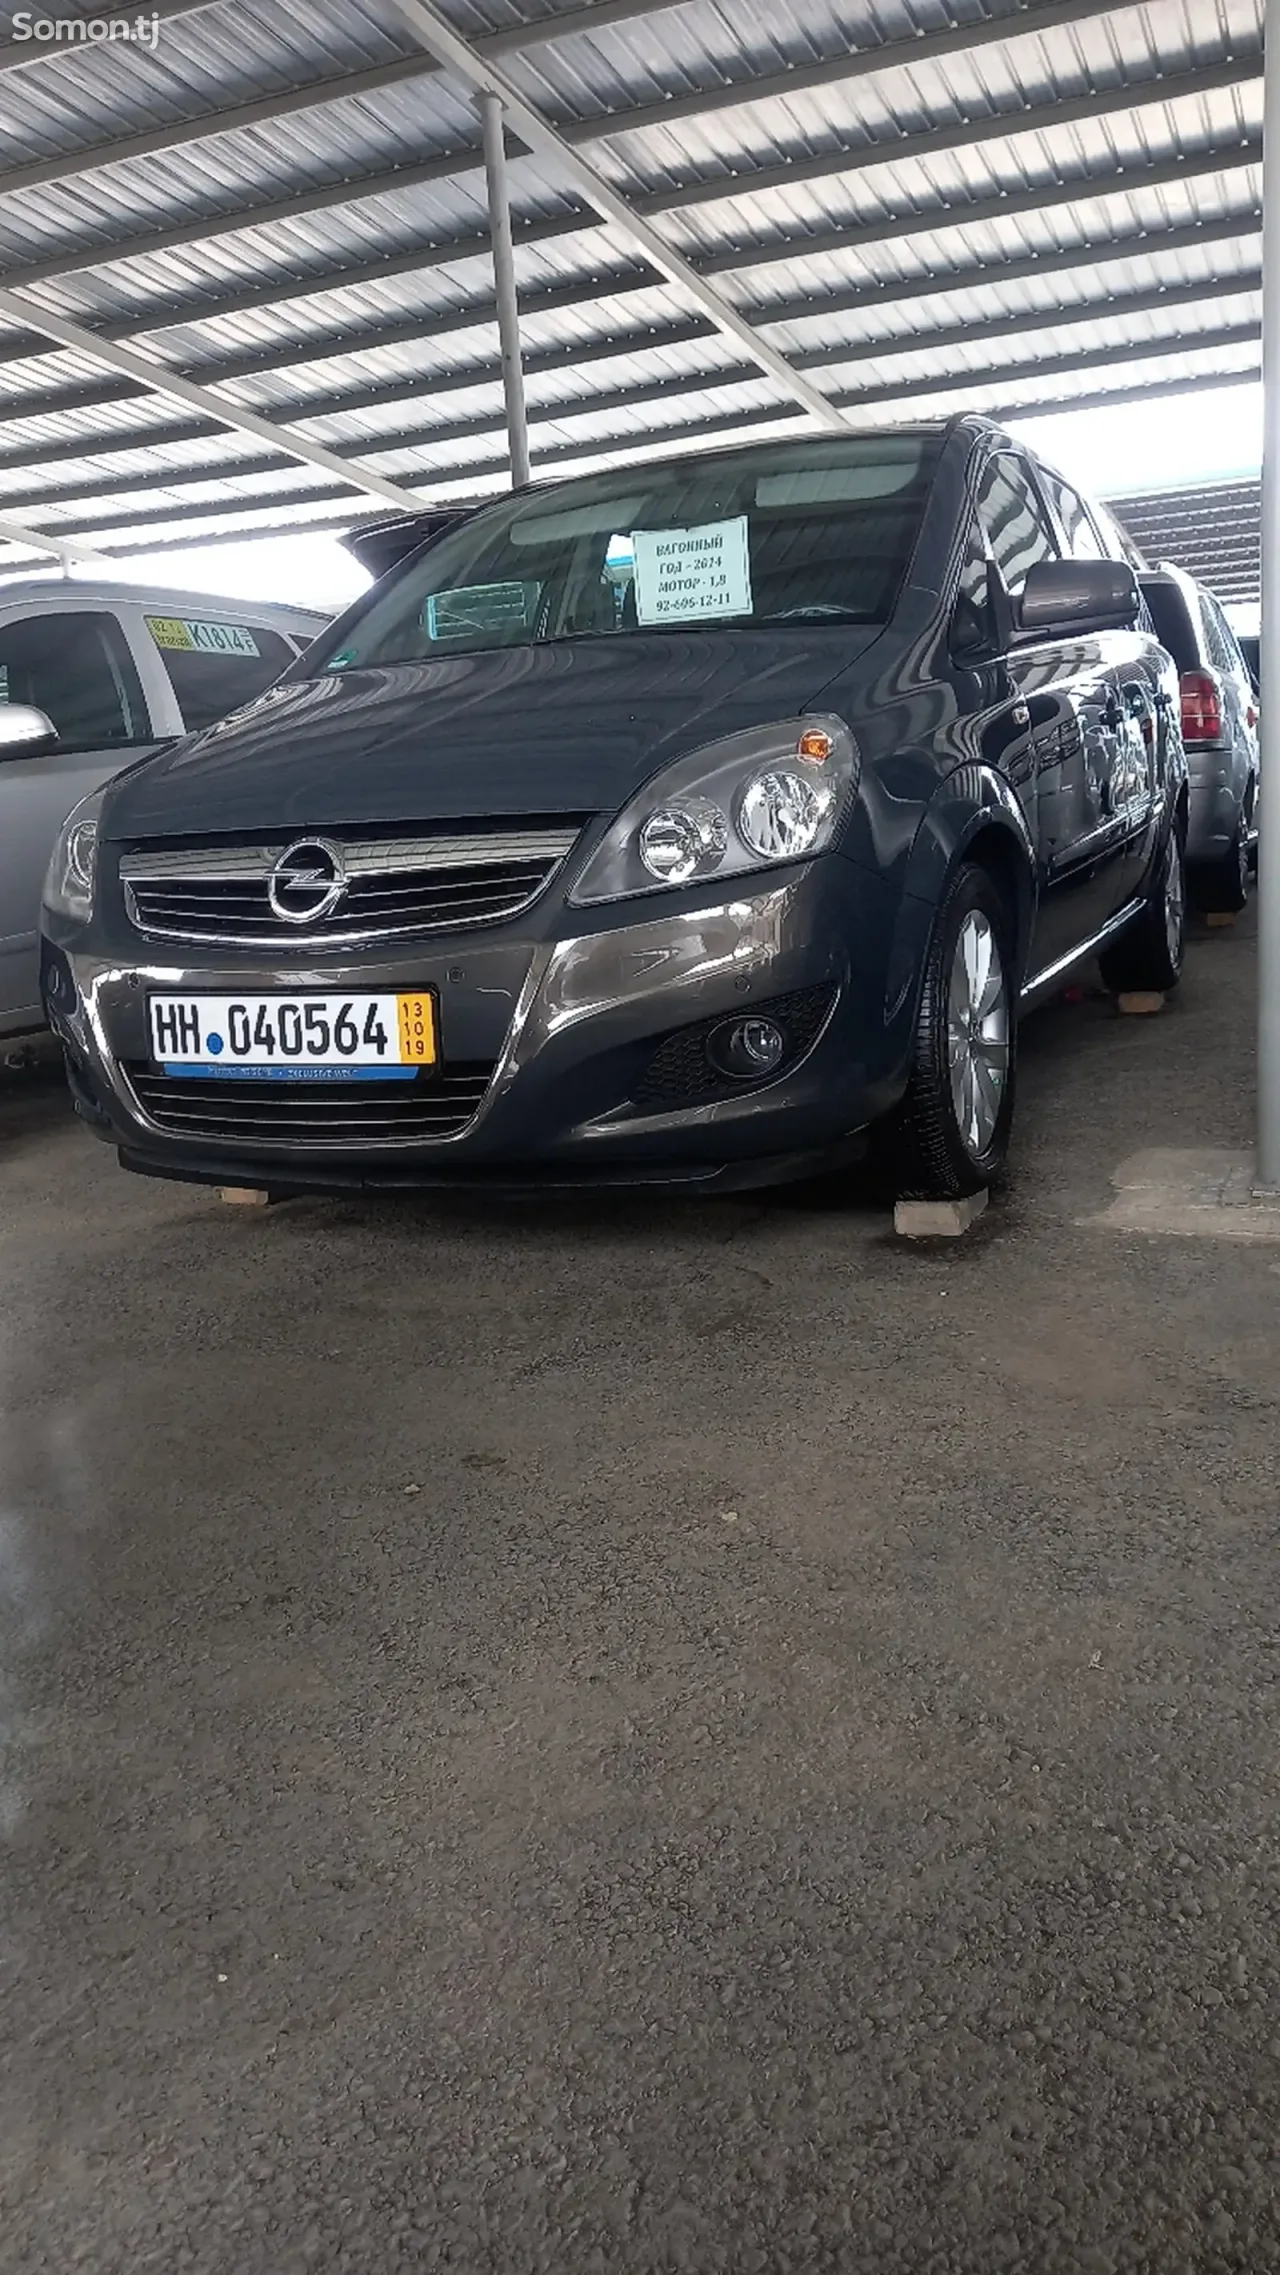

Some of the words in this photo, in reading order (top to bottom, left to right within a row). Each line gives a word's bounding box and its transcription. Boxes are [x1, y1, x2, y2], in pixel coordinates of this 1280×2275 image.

[656, 533, 724, 557] ВАГОННЫЙ
[659, 561, 682, 575] ГОД
[658, 577, 701, 593] МОТОР
[402, 1001, 423, 1018] 13
[228, 1003, 388, 1055] 040564
[404, 1021, 424, 1036] 10
[405, 1040, 425, 1055] 19
